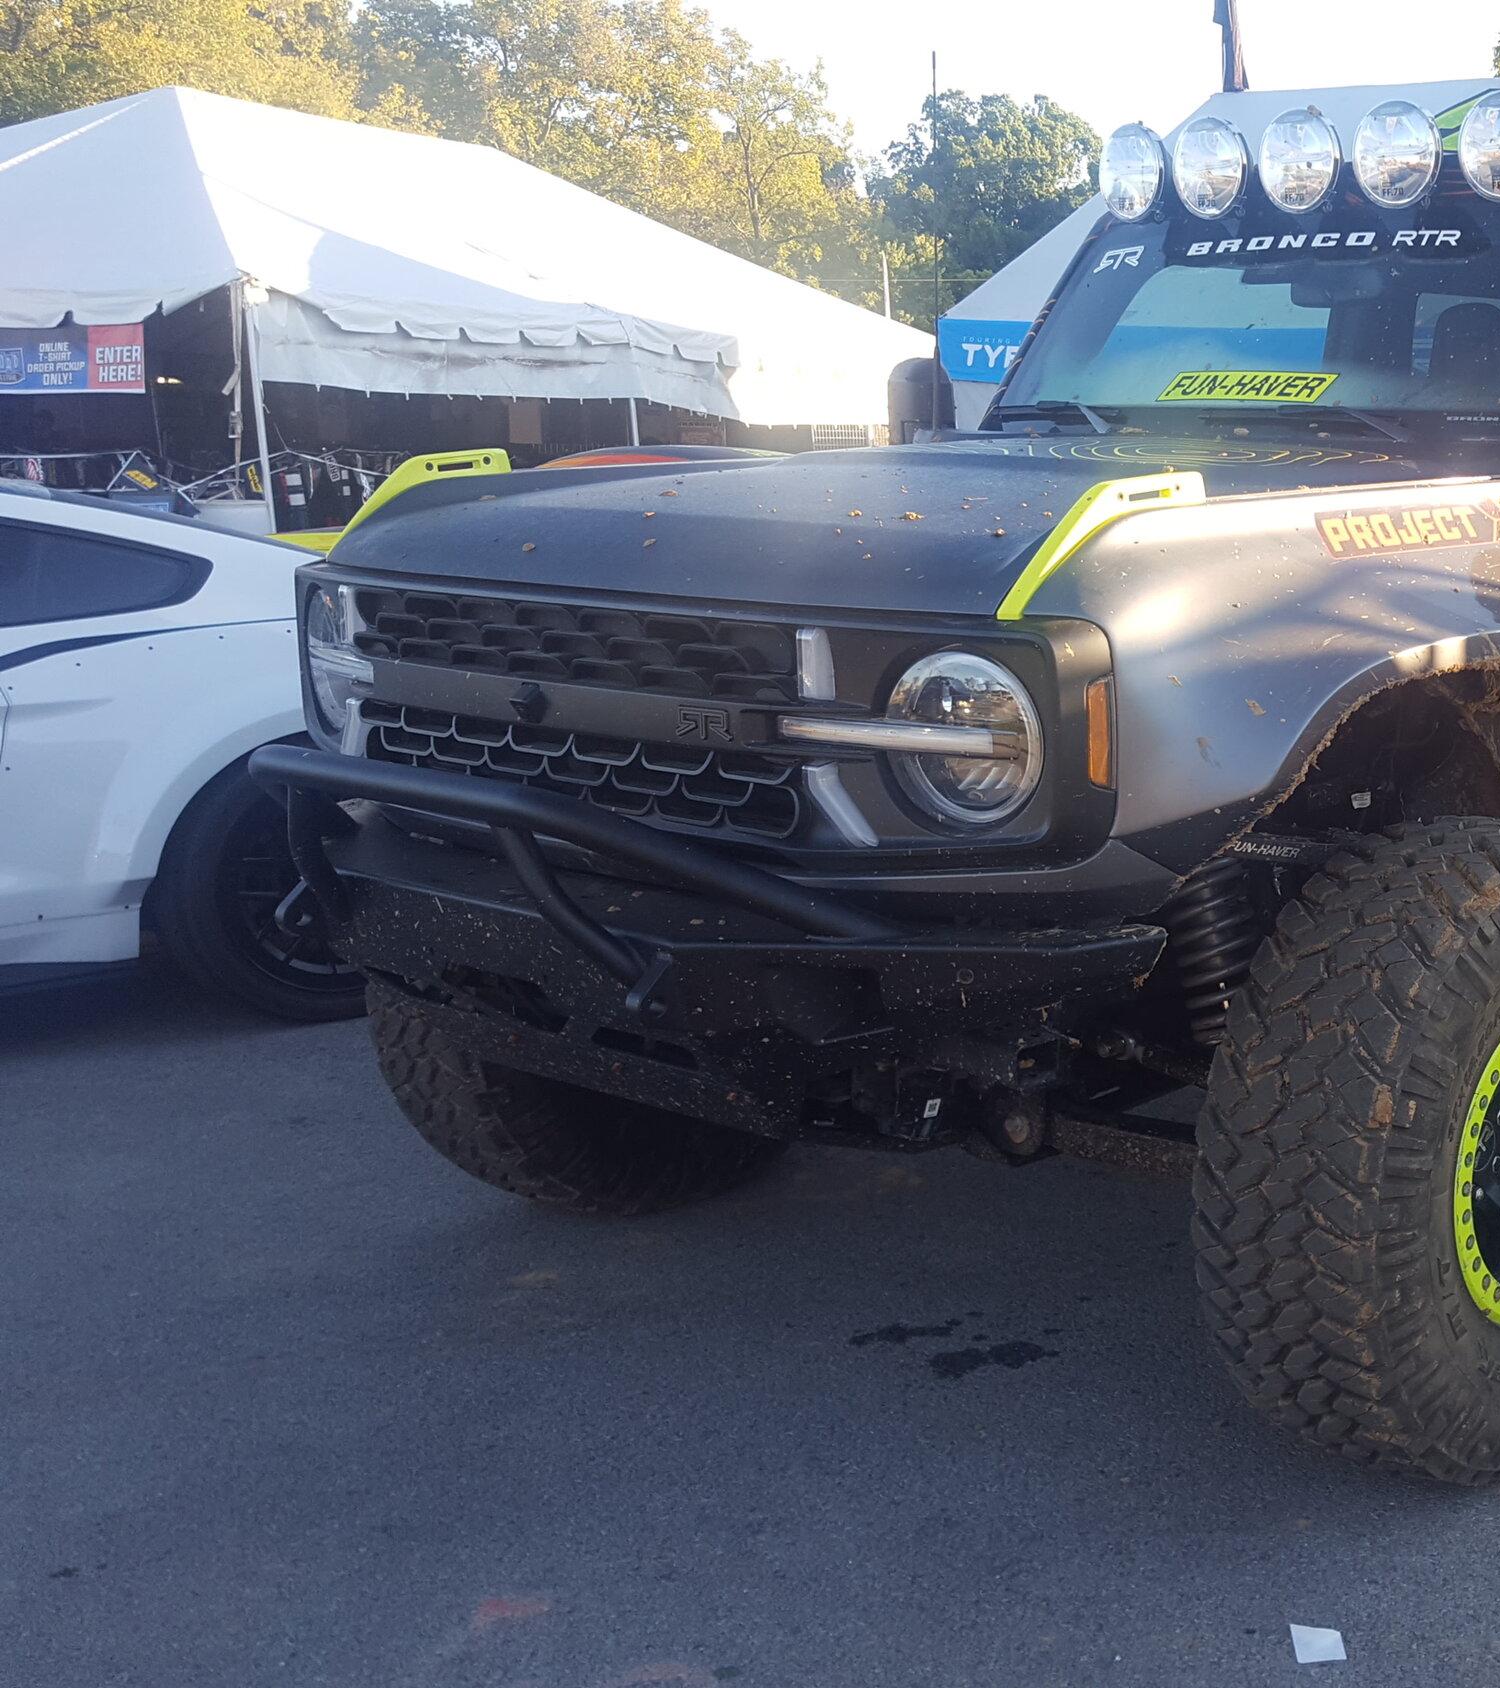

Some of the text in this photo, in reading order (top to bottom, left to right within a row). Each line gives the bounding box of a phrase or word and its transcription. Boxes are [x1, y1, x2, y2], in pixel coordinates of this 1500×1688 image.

[1186, 230, 1462, 256] BRONCO RTR
[39, 342, 70, 352] ONLINE
[962, 336, 1011, 344] TOURING
[39, 352, 72, 362] T-SHIRT
[96, 345, 142, 364] ENTER
[27, 361, 86, 373] ORDER PICKUP
[99, 365, 142, 382] HERE!
[43, 372, 73, 385] ONLY!
[1165, 375, 1327, 398] FUN-HAVER
[1321, 505, 1479, 552] PROJECT
